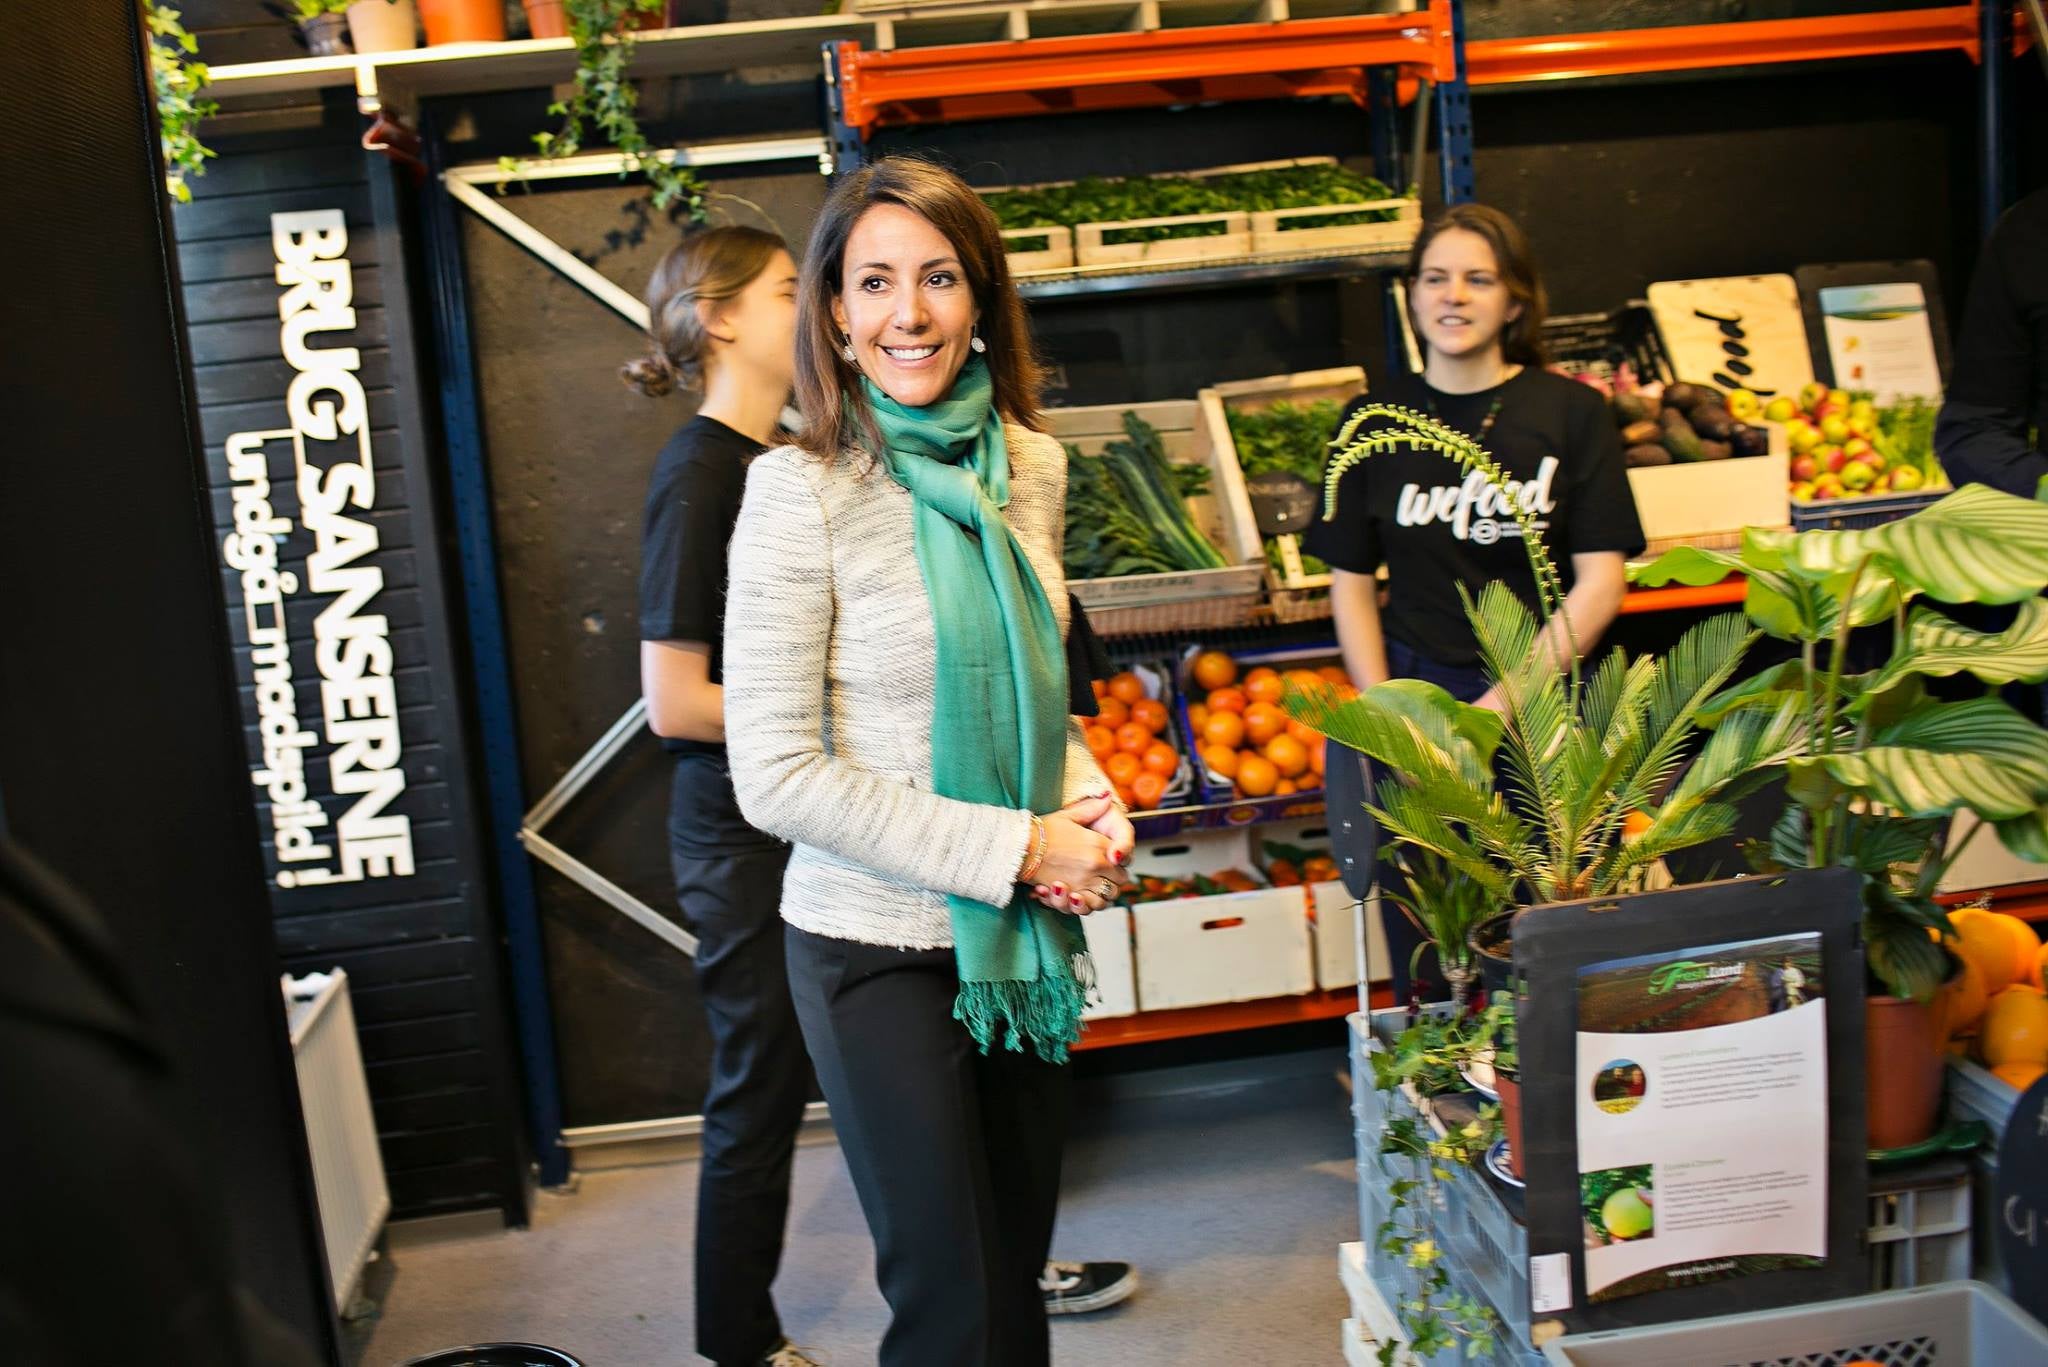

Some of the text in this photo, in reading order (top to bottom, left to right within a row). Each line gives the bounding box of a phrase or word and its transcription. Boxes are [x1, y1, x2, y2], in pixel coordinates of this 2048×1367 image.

[224, 430, 333, 888] undgå madspild!
[271, 208, 415, 881] BRUG SANSERNE
[1396, 456, 1560, 540] wefood
